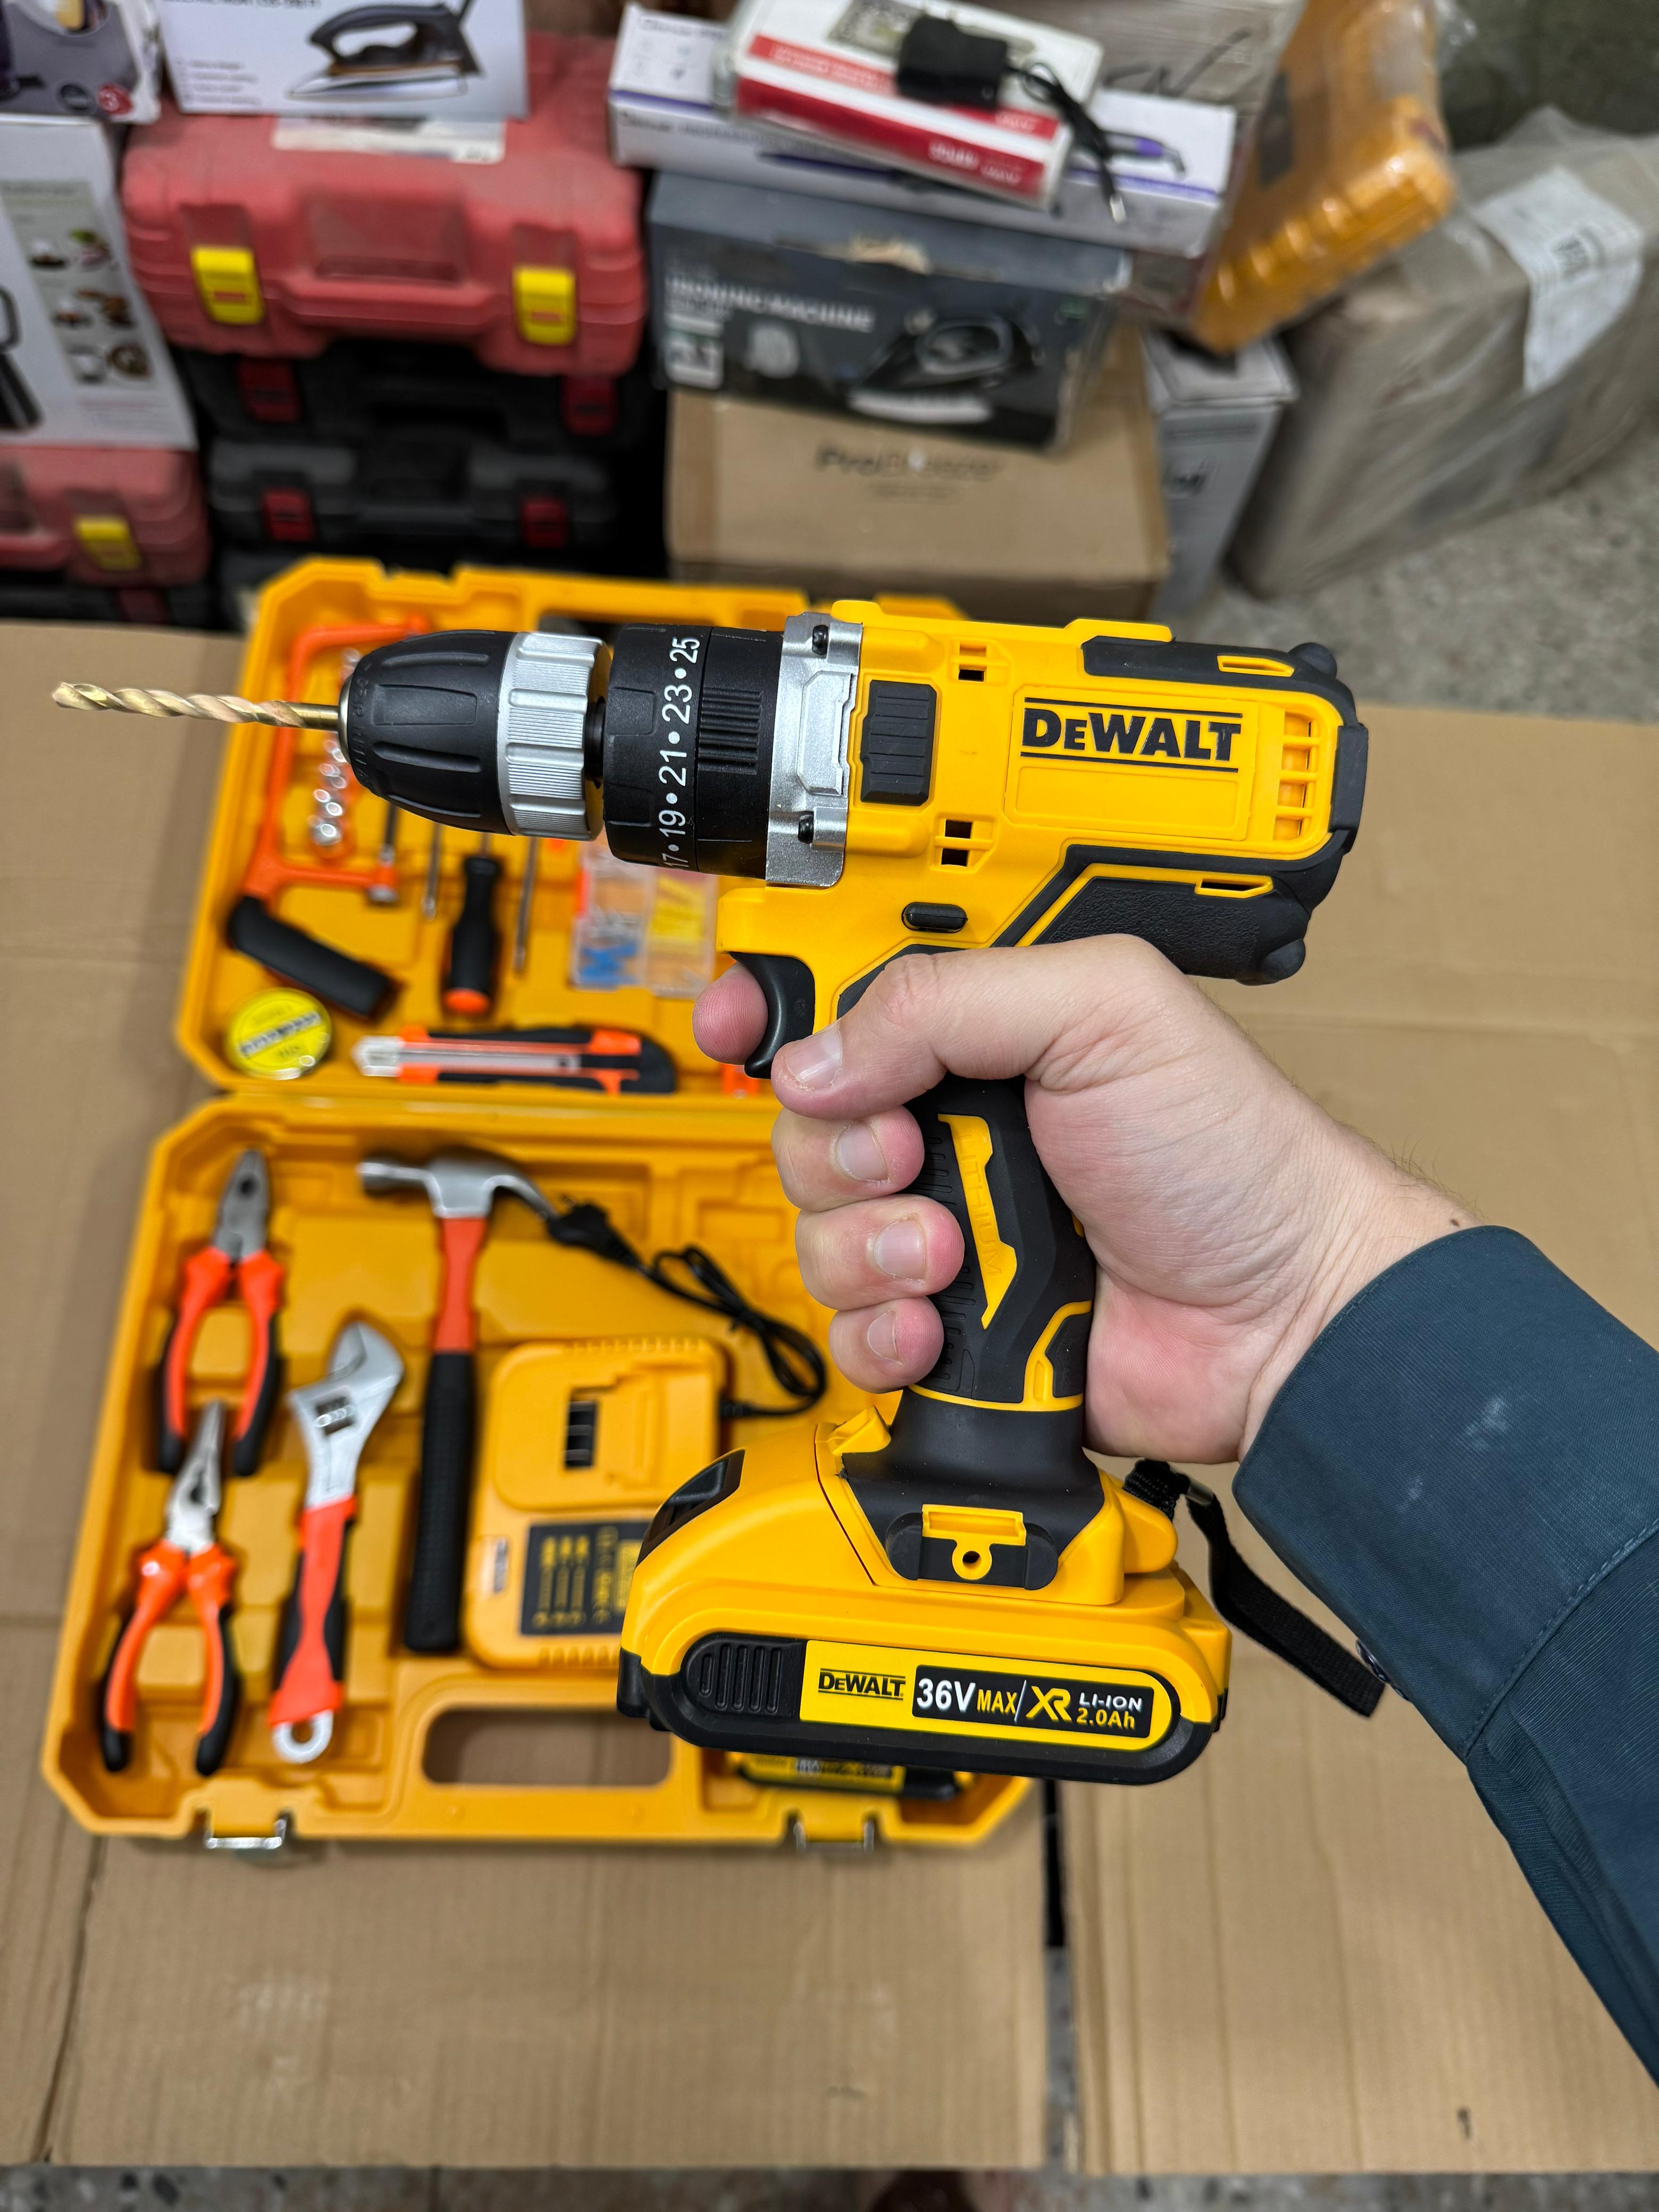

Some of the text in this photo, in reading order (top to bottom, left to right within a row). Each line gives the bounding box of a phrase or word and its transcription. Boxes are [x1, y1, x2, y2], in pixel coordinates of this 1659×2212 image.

[658, 638, 700, 867] 17 19 21 23 25
[958, 1134, 1002, 1276] LITHIUM
[917, 1678, 1072, 1722] 36V MAX XR
[1077, 1707, 1136, 1729] 2.0Ah
[1079, 1692, 1143, 1712] LI-ION
